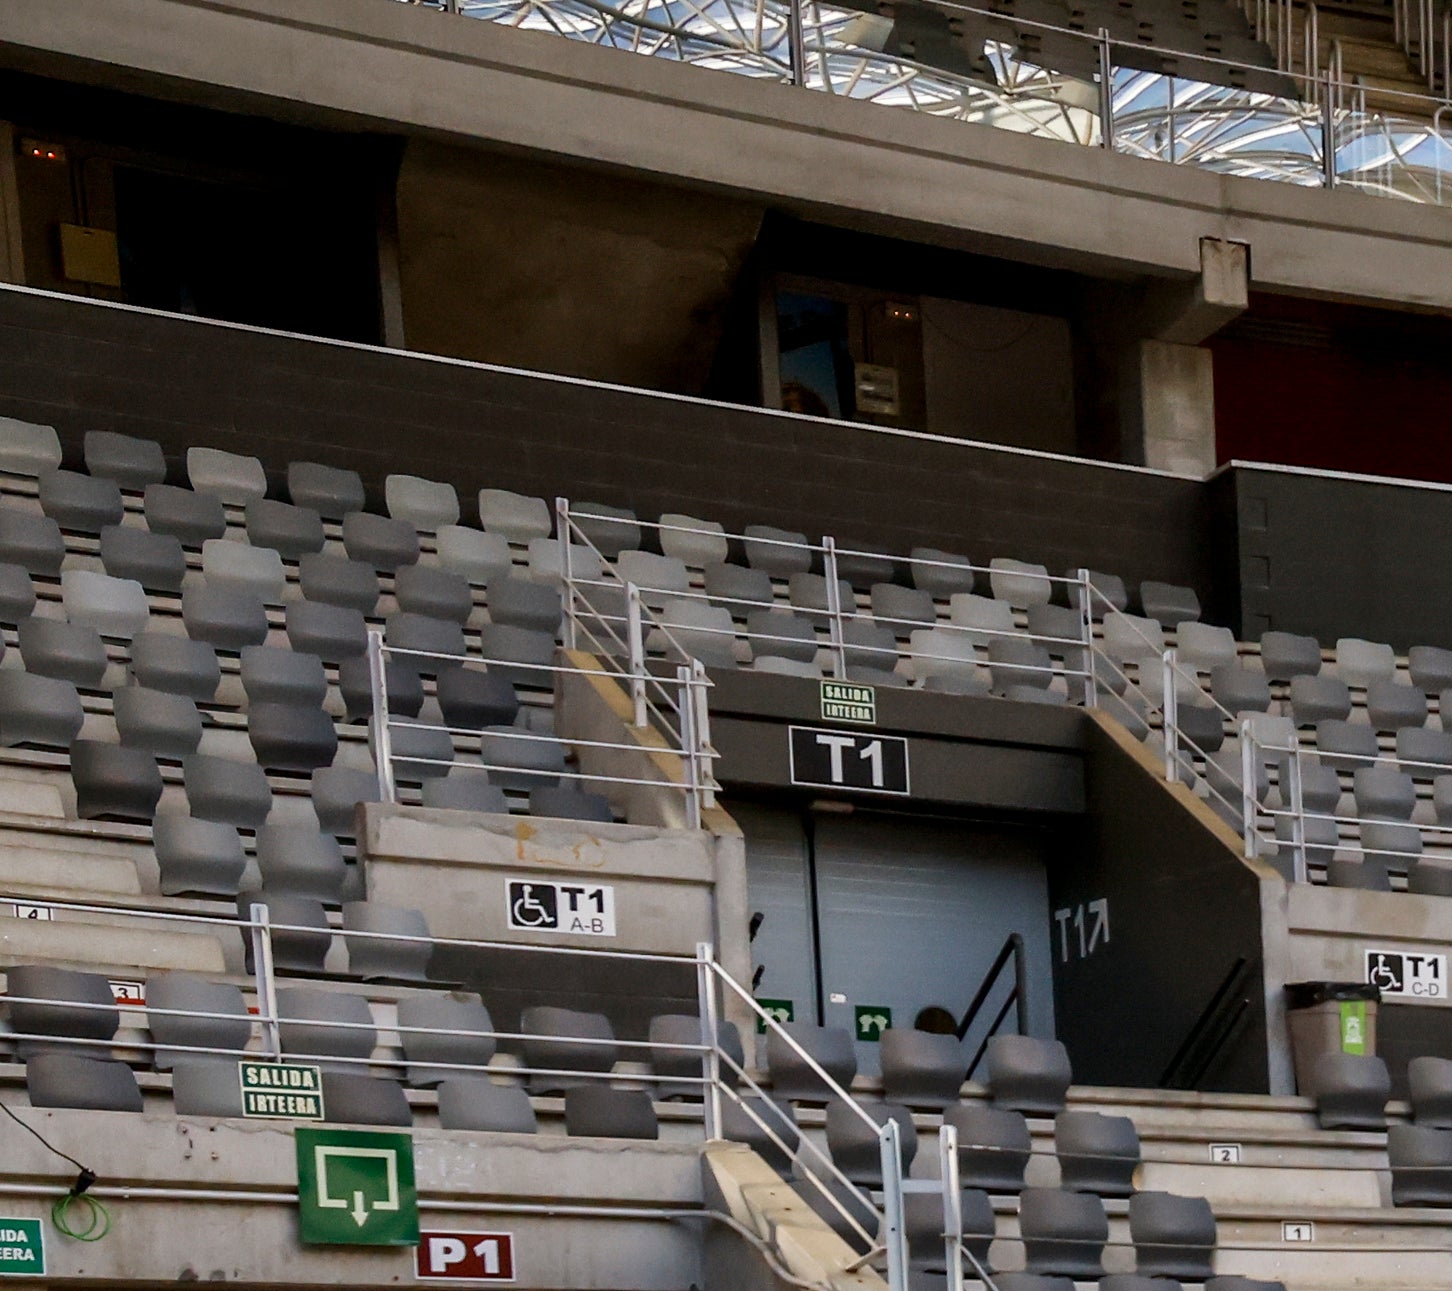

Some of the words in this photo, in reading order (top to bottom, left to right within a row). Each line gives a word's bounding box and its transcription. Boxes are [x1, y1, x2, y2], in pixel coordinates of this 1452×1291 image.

[824, 685, 870, 702] SALIDA
[815, 734, 884, 787] T1
[560, 886, 604, 913] T1
[570, 917, 604, 933] A-B
[1054, 904, 1087, 962] T1
[1406, 956, 1440, 979] T1
[1412, 982, 1439, 996] C-D
[246, 1066, 314, 1088] SALIDA
[248, 1093, 317, 1115] IRTEERA
[1221, 1149, 1230, 1161] 2
[0, 1229, 28, 1243] IDA
[1294, 1228, 1302, 1239] 1
[0, 1247, 35, 1261] ERA
[428, 1237, 500, 1274] P1
